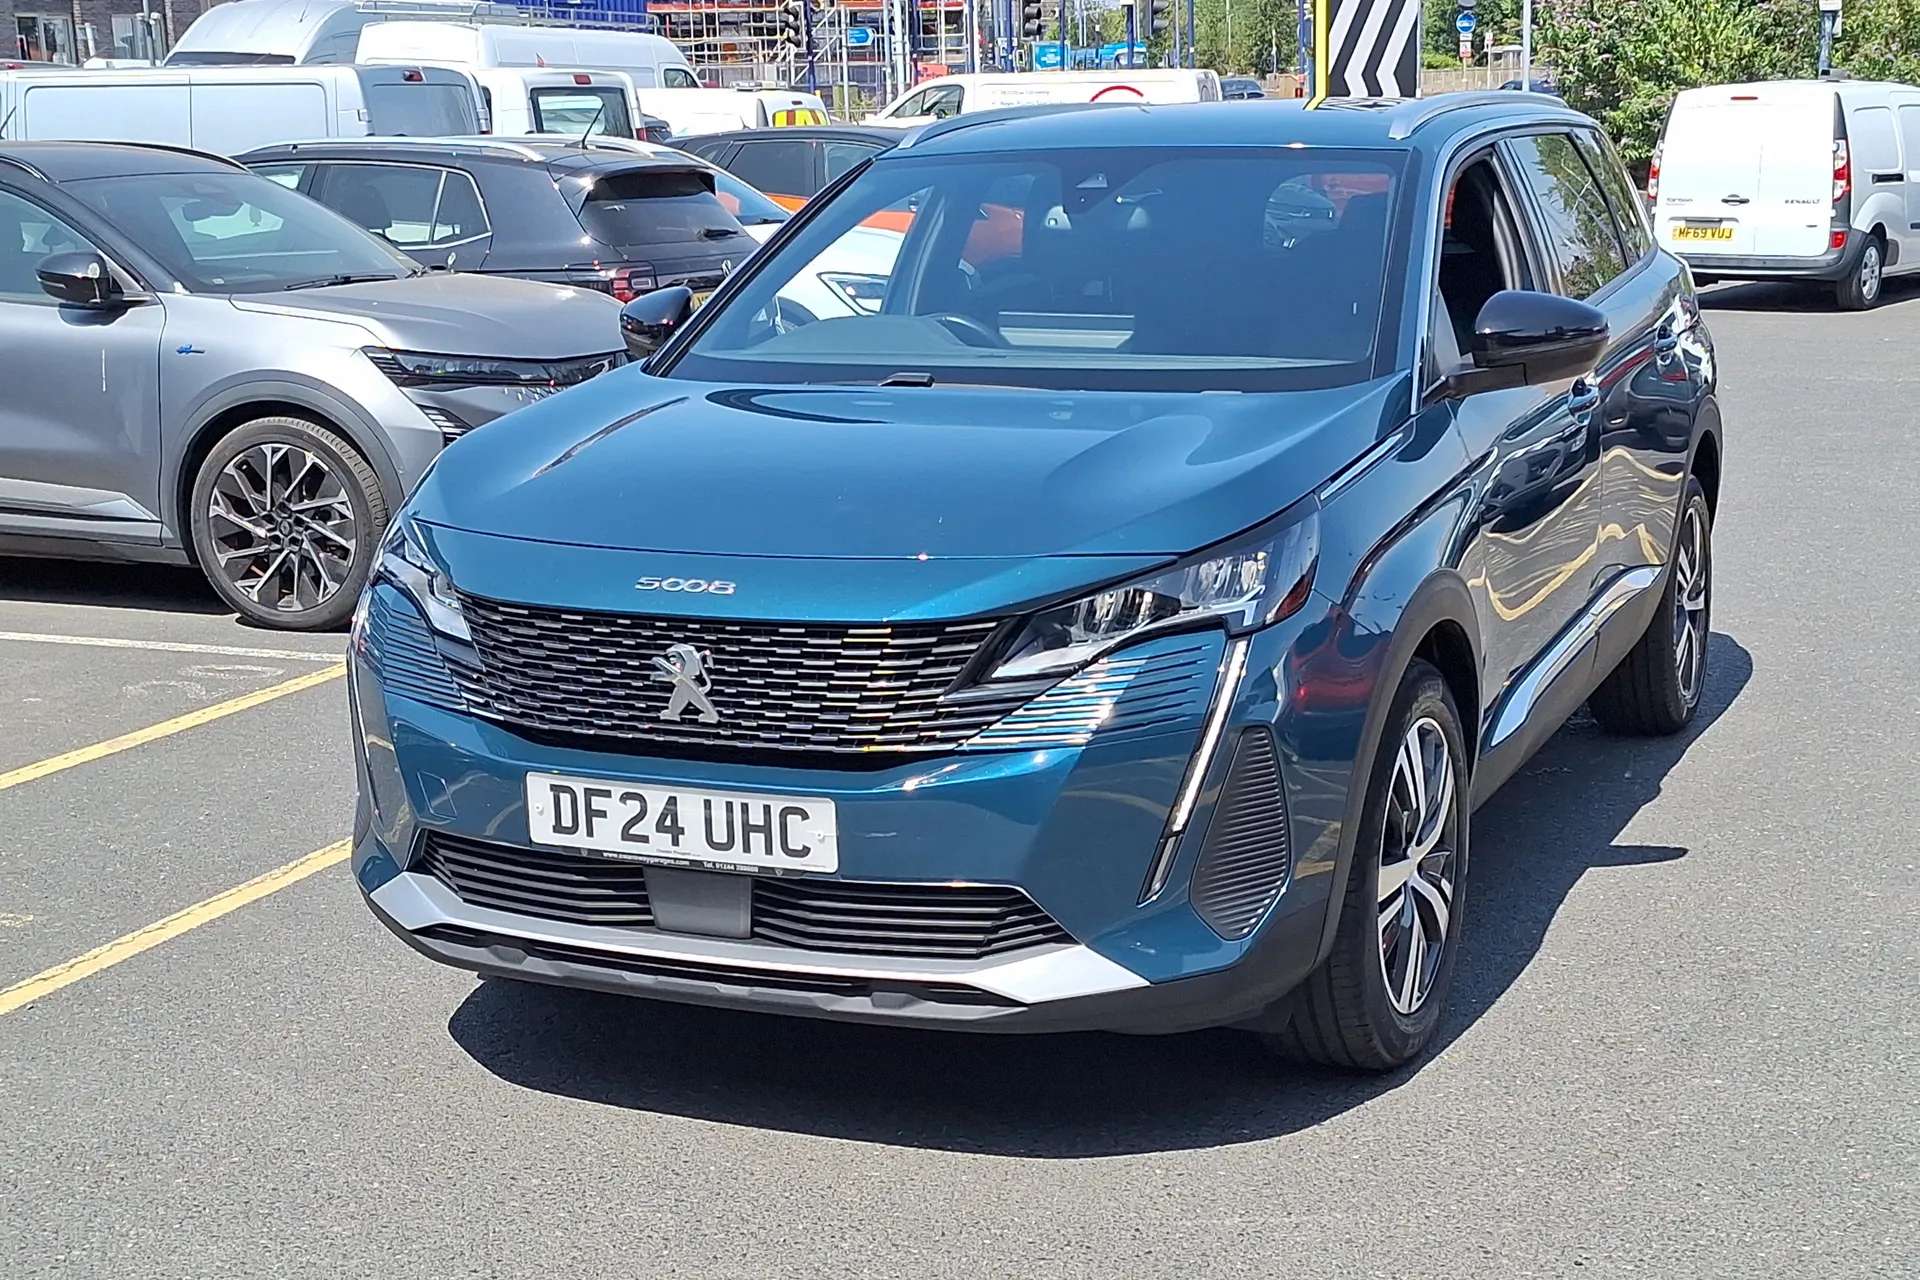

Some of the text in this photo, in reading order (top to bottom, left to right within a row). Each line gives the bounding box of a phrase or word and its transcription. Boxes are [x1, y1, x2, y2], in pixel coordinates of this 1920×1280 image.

[1678, 228, 1733, 239] MF69 VUJ
[635, 577, 737, 595] 5008
[550, 784, 811, 858] DF24 UHC
